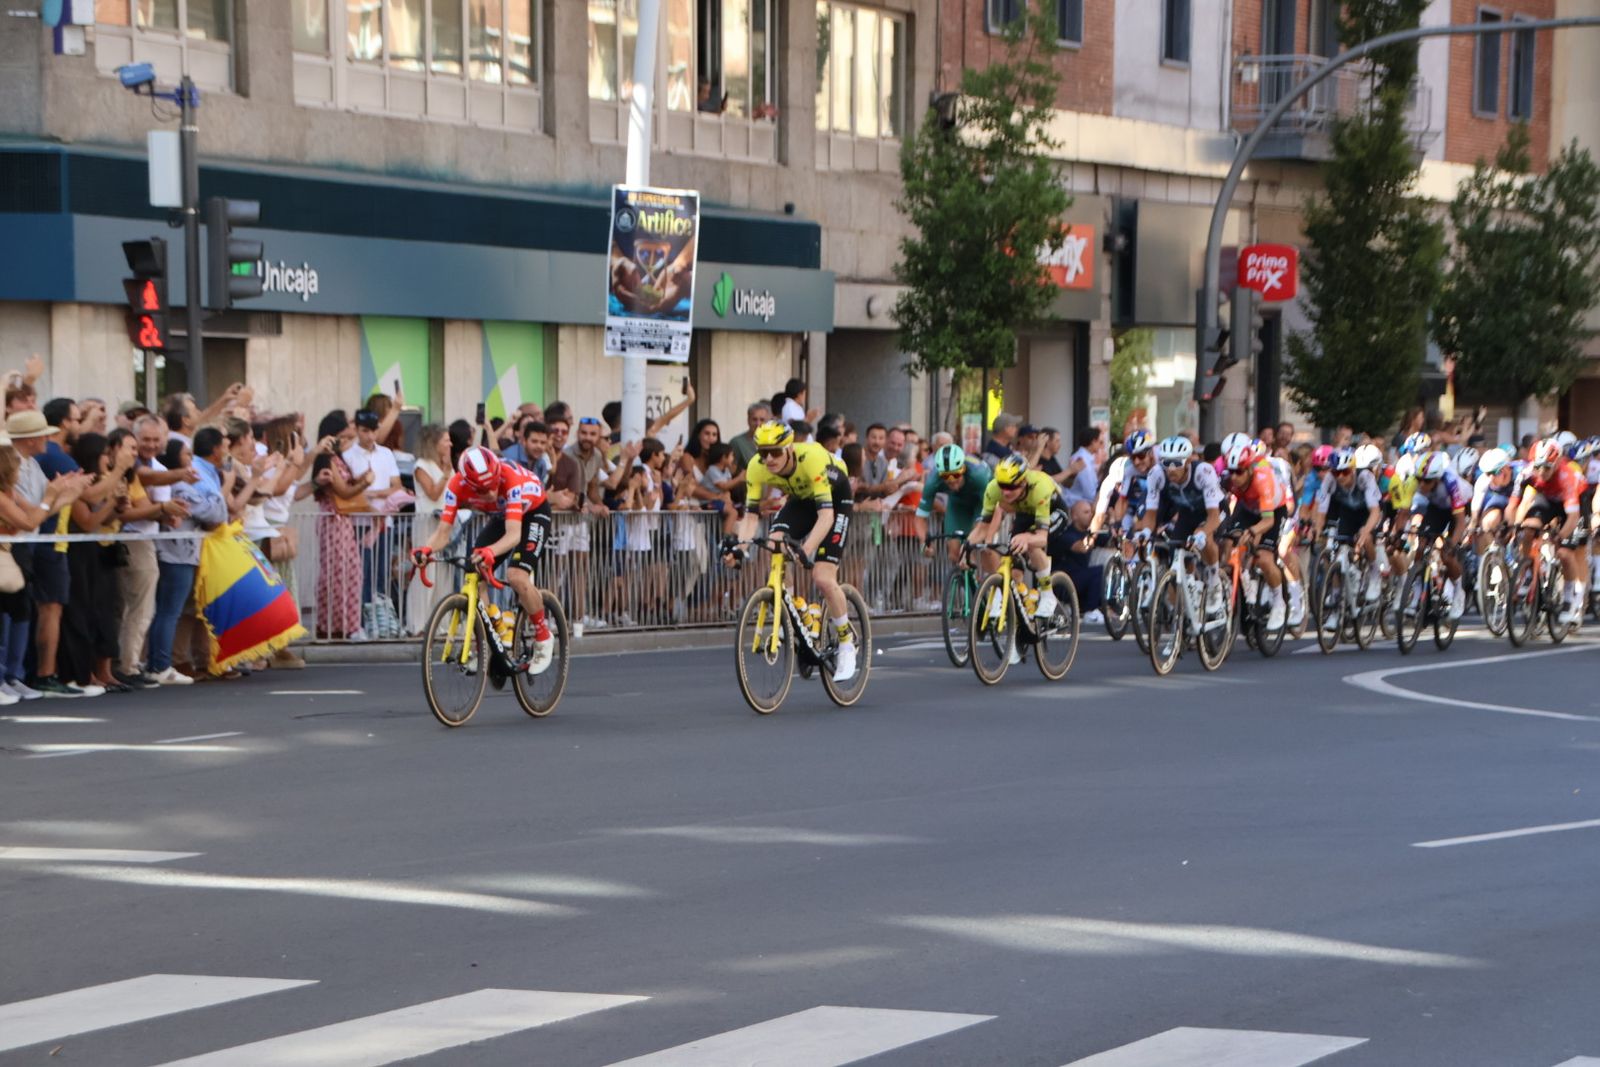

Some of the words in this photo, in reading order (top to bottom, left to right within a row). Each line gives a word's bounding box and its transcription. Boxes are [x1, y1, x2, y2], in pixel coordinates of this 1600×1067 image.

[1247, 252, 1288, 269] Prima
[256, 259, 319, 302] Unicaja
[735, 288, 775, 323] Unicaja
